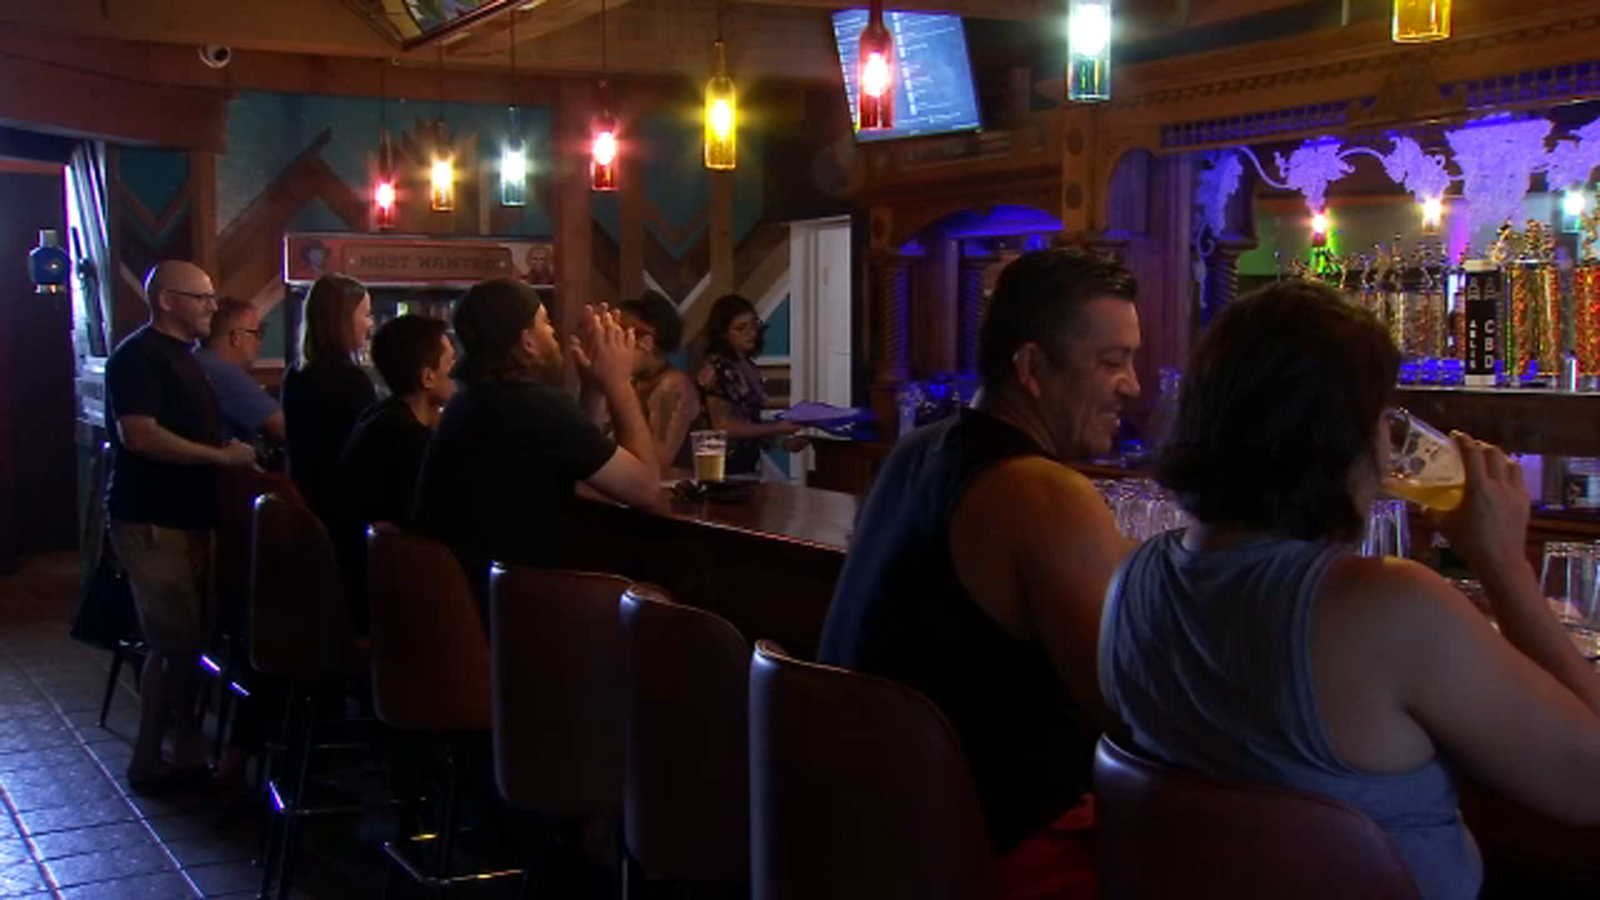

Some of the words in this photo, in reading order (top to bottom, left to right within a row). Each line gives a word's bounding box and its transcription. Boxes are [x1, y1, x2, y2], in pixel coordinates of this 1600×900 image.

[360, 255, 410, 268] MOST
[418, 256, 497, 270] WANTED
[1484, 319, 1495, 369] CBD
